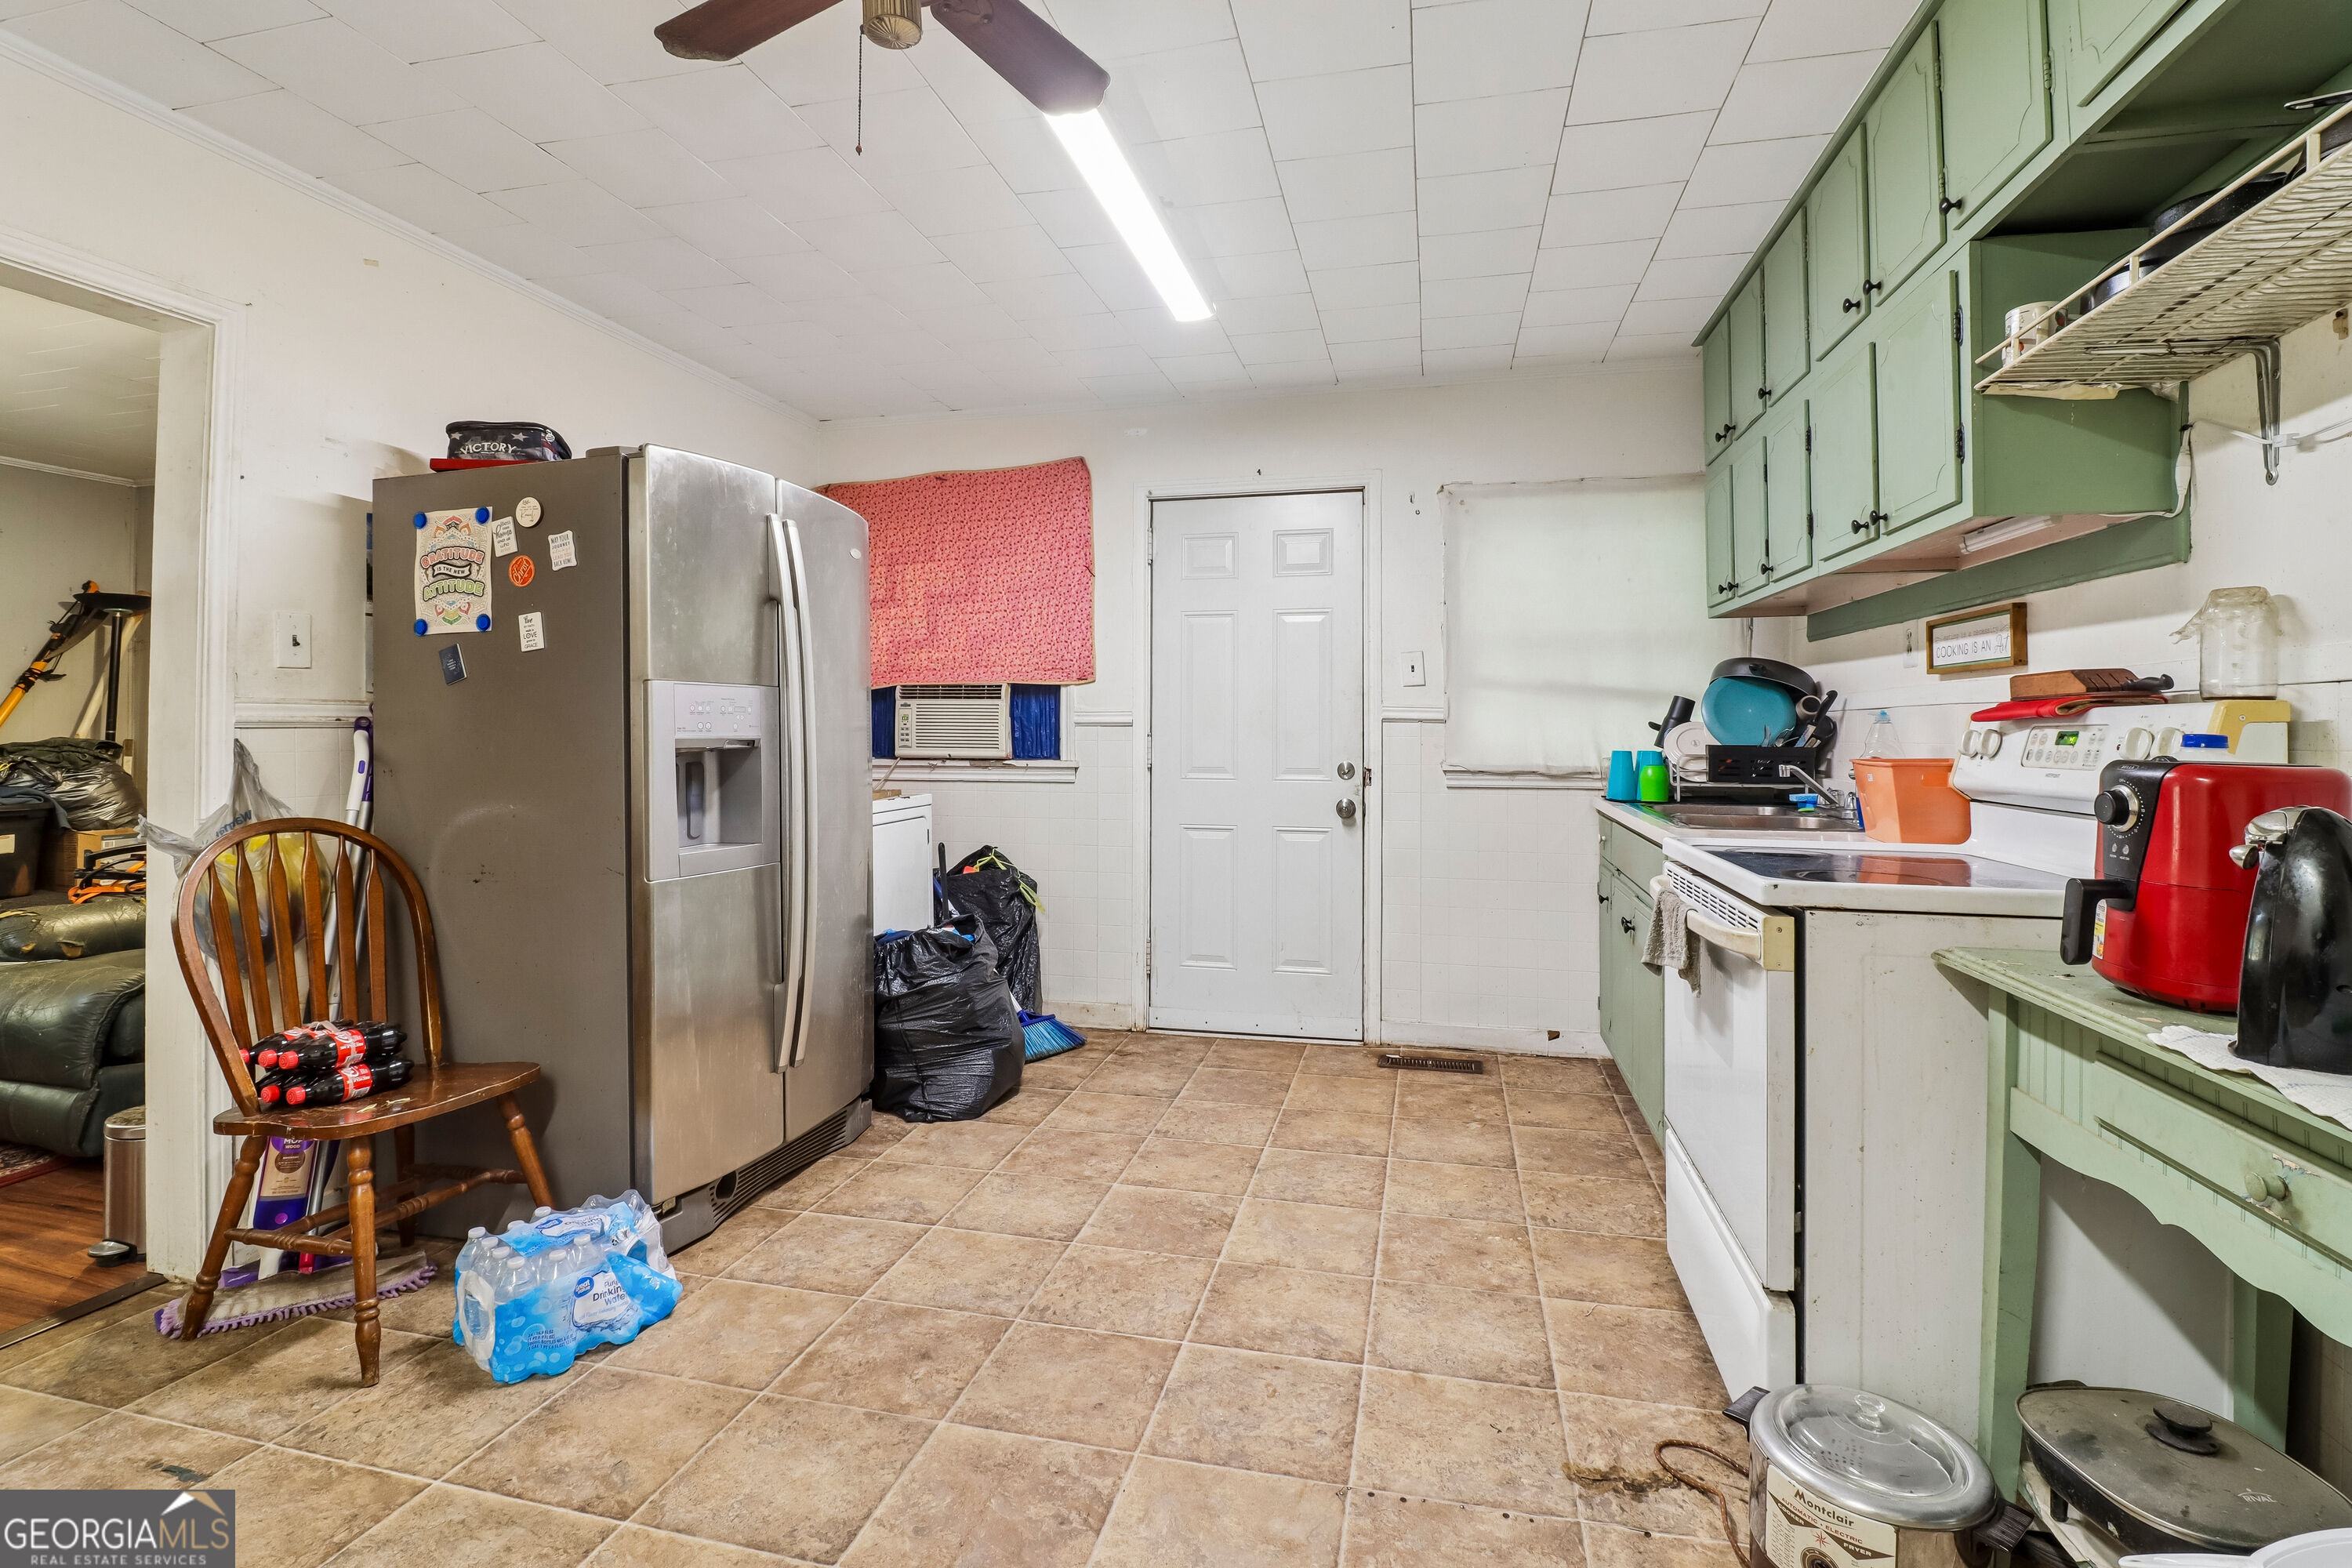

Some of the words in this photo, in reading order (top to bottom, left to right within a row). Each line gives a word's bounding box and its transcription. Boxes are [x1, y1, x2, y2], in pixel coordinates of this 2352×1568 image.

[460, 442, 517, 454] VICTORY
[420, 547, 485, 568] GRATITUDE
[423, 579, 485, 601] ATTITUDE
[523, 631, 538, 640] LOVE
[1936, 643, 1969, 659] COOKING
[1971, 641, 1977, 654] IS
[1980, 640, 1991, 652] AN
[1778, 1504, 1805, 1526] COOKER
[1794, 1489, 1855, 1526] Montclair
[1781, 1497, 1818, 1524] AUTOMATIC
[1825, 1526, 1863, 1544] ELECTRIC
[1843, 1542, 1872, 1557] FRYER
